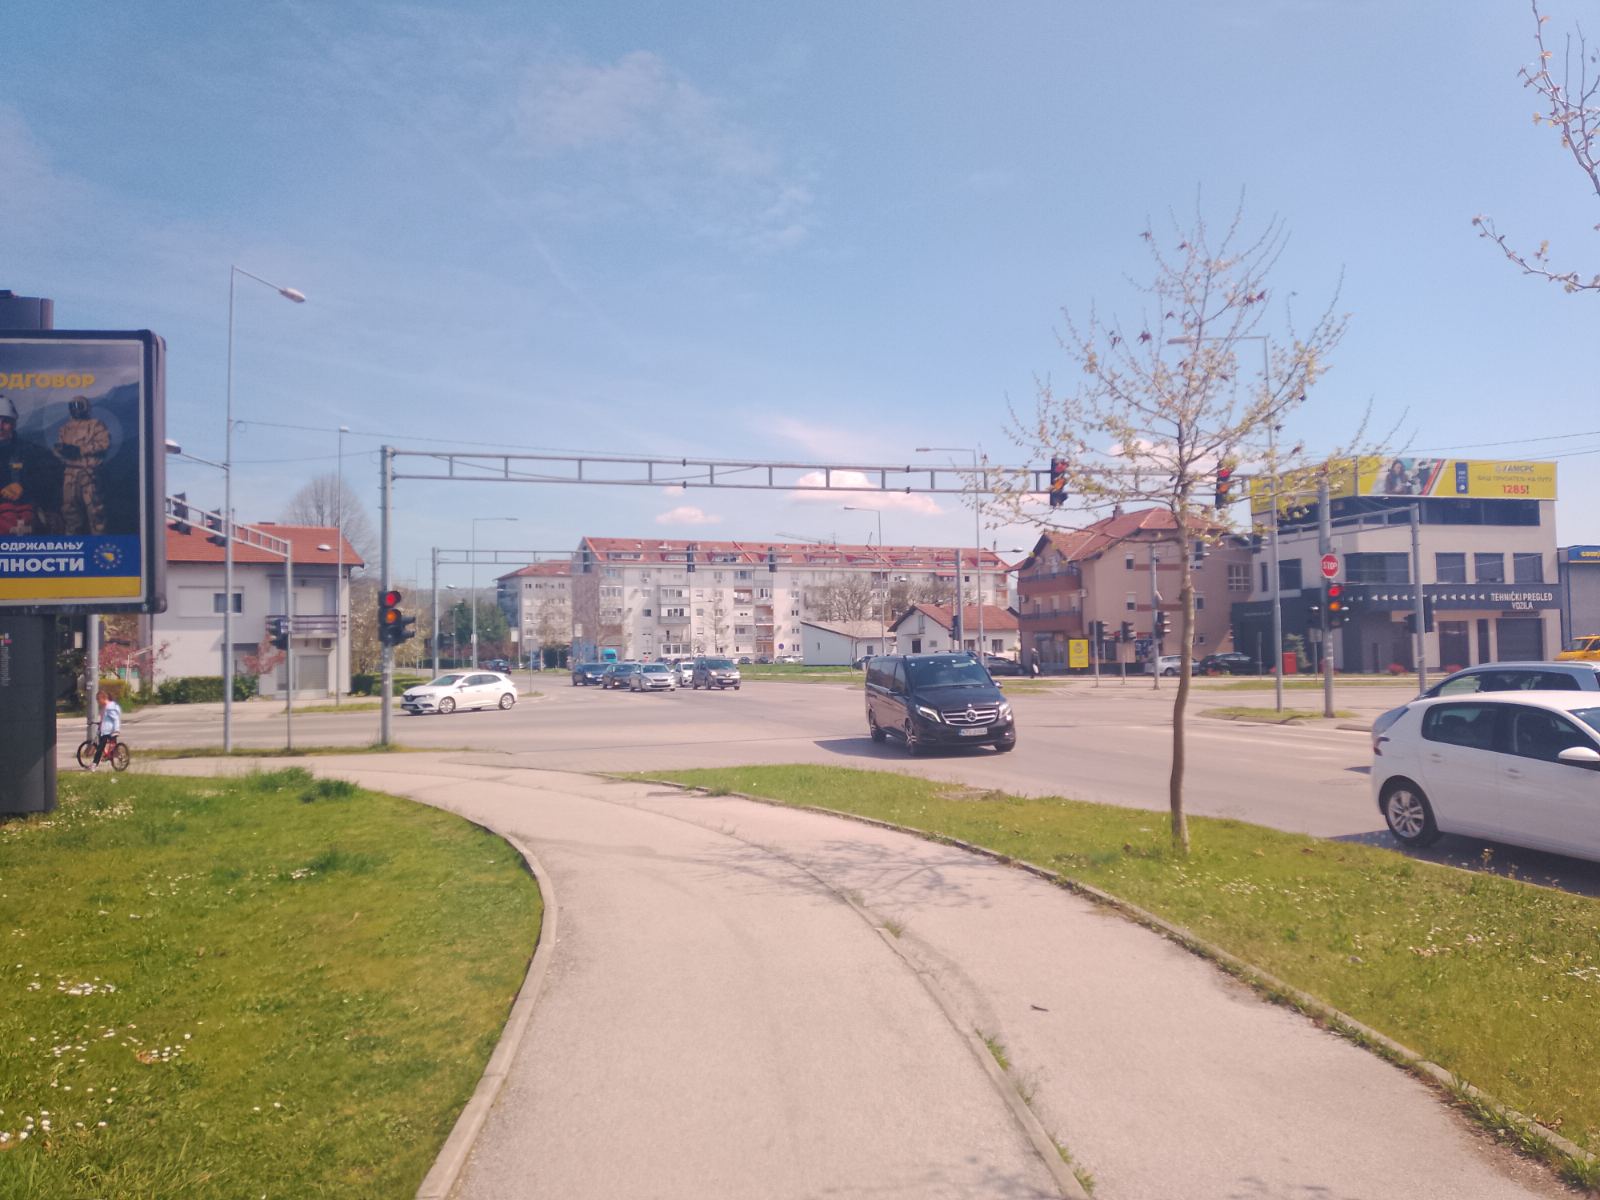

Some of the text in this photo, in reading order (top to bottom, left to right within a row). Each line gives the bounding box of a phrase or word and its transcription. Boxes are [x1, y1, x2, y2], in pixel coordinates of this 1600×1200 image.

[0, 541, 84, 551] ОДРЖАВАЊУ
[1323, 561, 1337, 570] STOP
[1523, 592, 1553, 602] PREGLED
[1511, 601, 1534, 609] VOZILA
